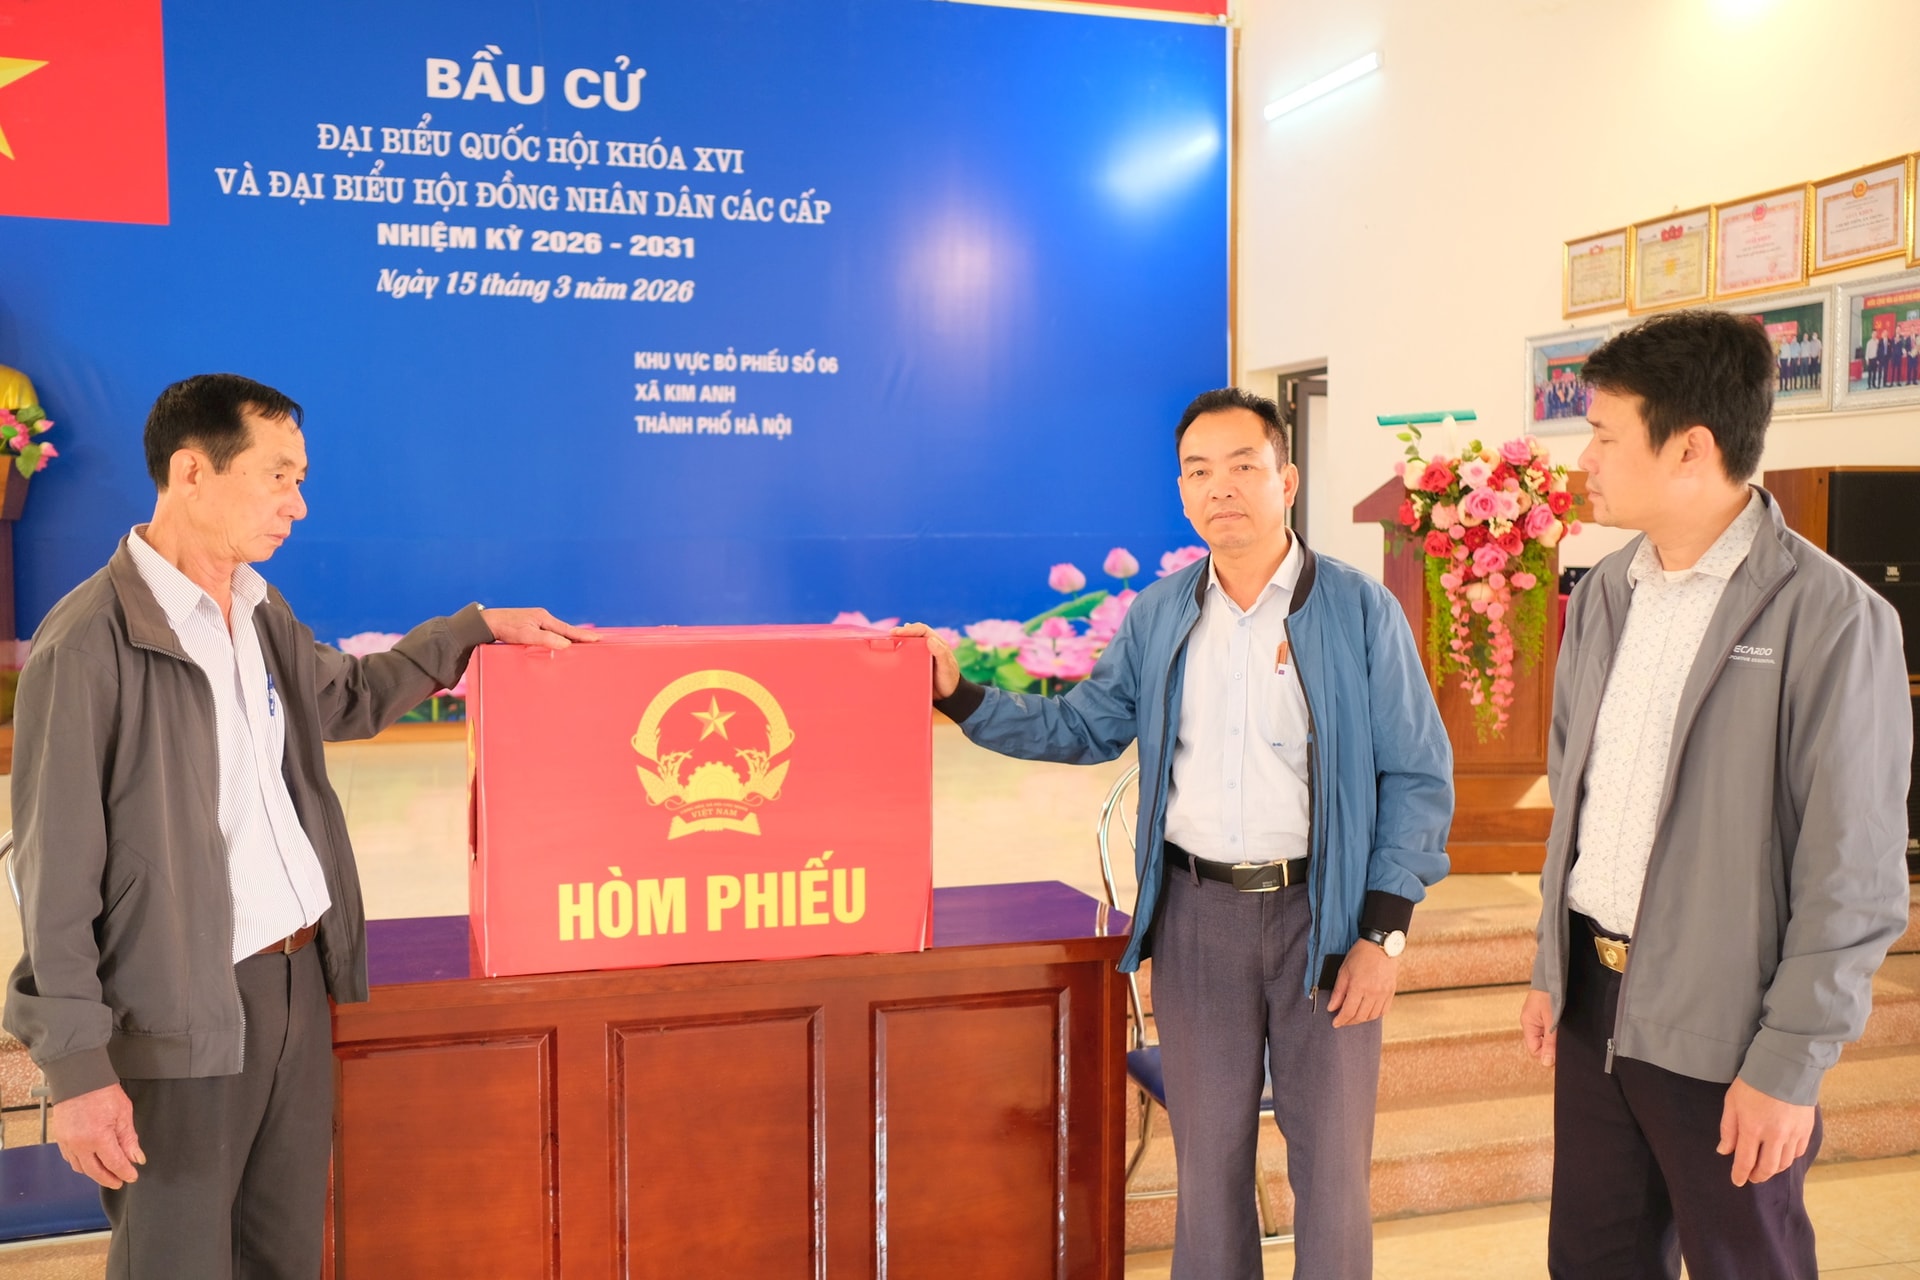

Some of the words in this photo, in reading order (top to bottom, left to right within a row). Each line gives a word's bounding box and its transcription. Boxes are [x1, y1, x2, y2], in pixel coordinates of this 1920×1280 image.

[426, 44, 545, 105] BẦU
[563, 54, 647, 112] CỬ
[316, 123, 374, 159] ĐẠI
[380, 112, 453, 158] BIỂU
[459, 123, 541, 162] QUỐC
[546, 130, 600, 171] HỘI
[606, 136, 688, 171] KHÓA
[693, 146, 745, 175] XVI
[214, 160, 261, 197] VÀ
[268, 170, 326, 206] ĐẠI
[332, 158, 406, 204] BIỂU
[412, 171, 469, 213] HỘI
[475, 169, 560, 212] ĐỒNG
[565, 180, 649, 216] NHÂN
[654, 184, 716, 219] DÂN
[721, 188, 775, 223] CÁC
[778, 188, 832, 225] CẤP
[377, 220, 477, 253] NHIỆM
[485, 224, 524, 251] KỲ
[531, 229, 603, 255] 2026
[629, 234, 695, 259] 2031
[376, 267, 440, 300] Ngày
[446, 271, 478, 296] 15
[479, 271, 551, 304] tháng
[552, 274, 573, 299] 3
[574, 276, 628, 301] năm
[630, 277, 696, 303] 2026
[634, 351, 672, 371] KHU
[673, 351, 711, 376] VỰC
[713, 346, 738, 372] BỎ
[740, 348, 790, 373] PHIẾU
[791, 348, 816, 374] SỐ
[817, 356, 839, 374] 06
[634, 379, 662, 402] XÃ
[663, 383, 697, 403] KIM
[699, 384, 737, 403] ANH
[634, 411, 694, 435] THÀNH
[696, 409, 732, 435] PHỐ
[734, 413, 760, 435] HÀ
[761, 413, 792, 441] NỘI
[715, 807, 738, 818] NAM
[558, 865, 687, 942] HÒM
[706, 850, 866, 932] PHIẾU
